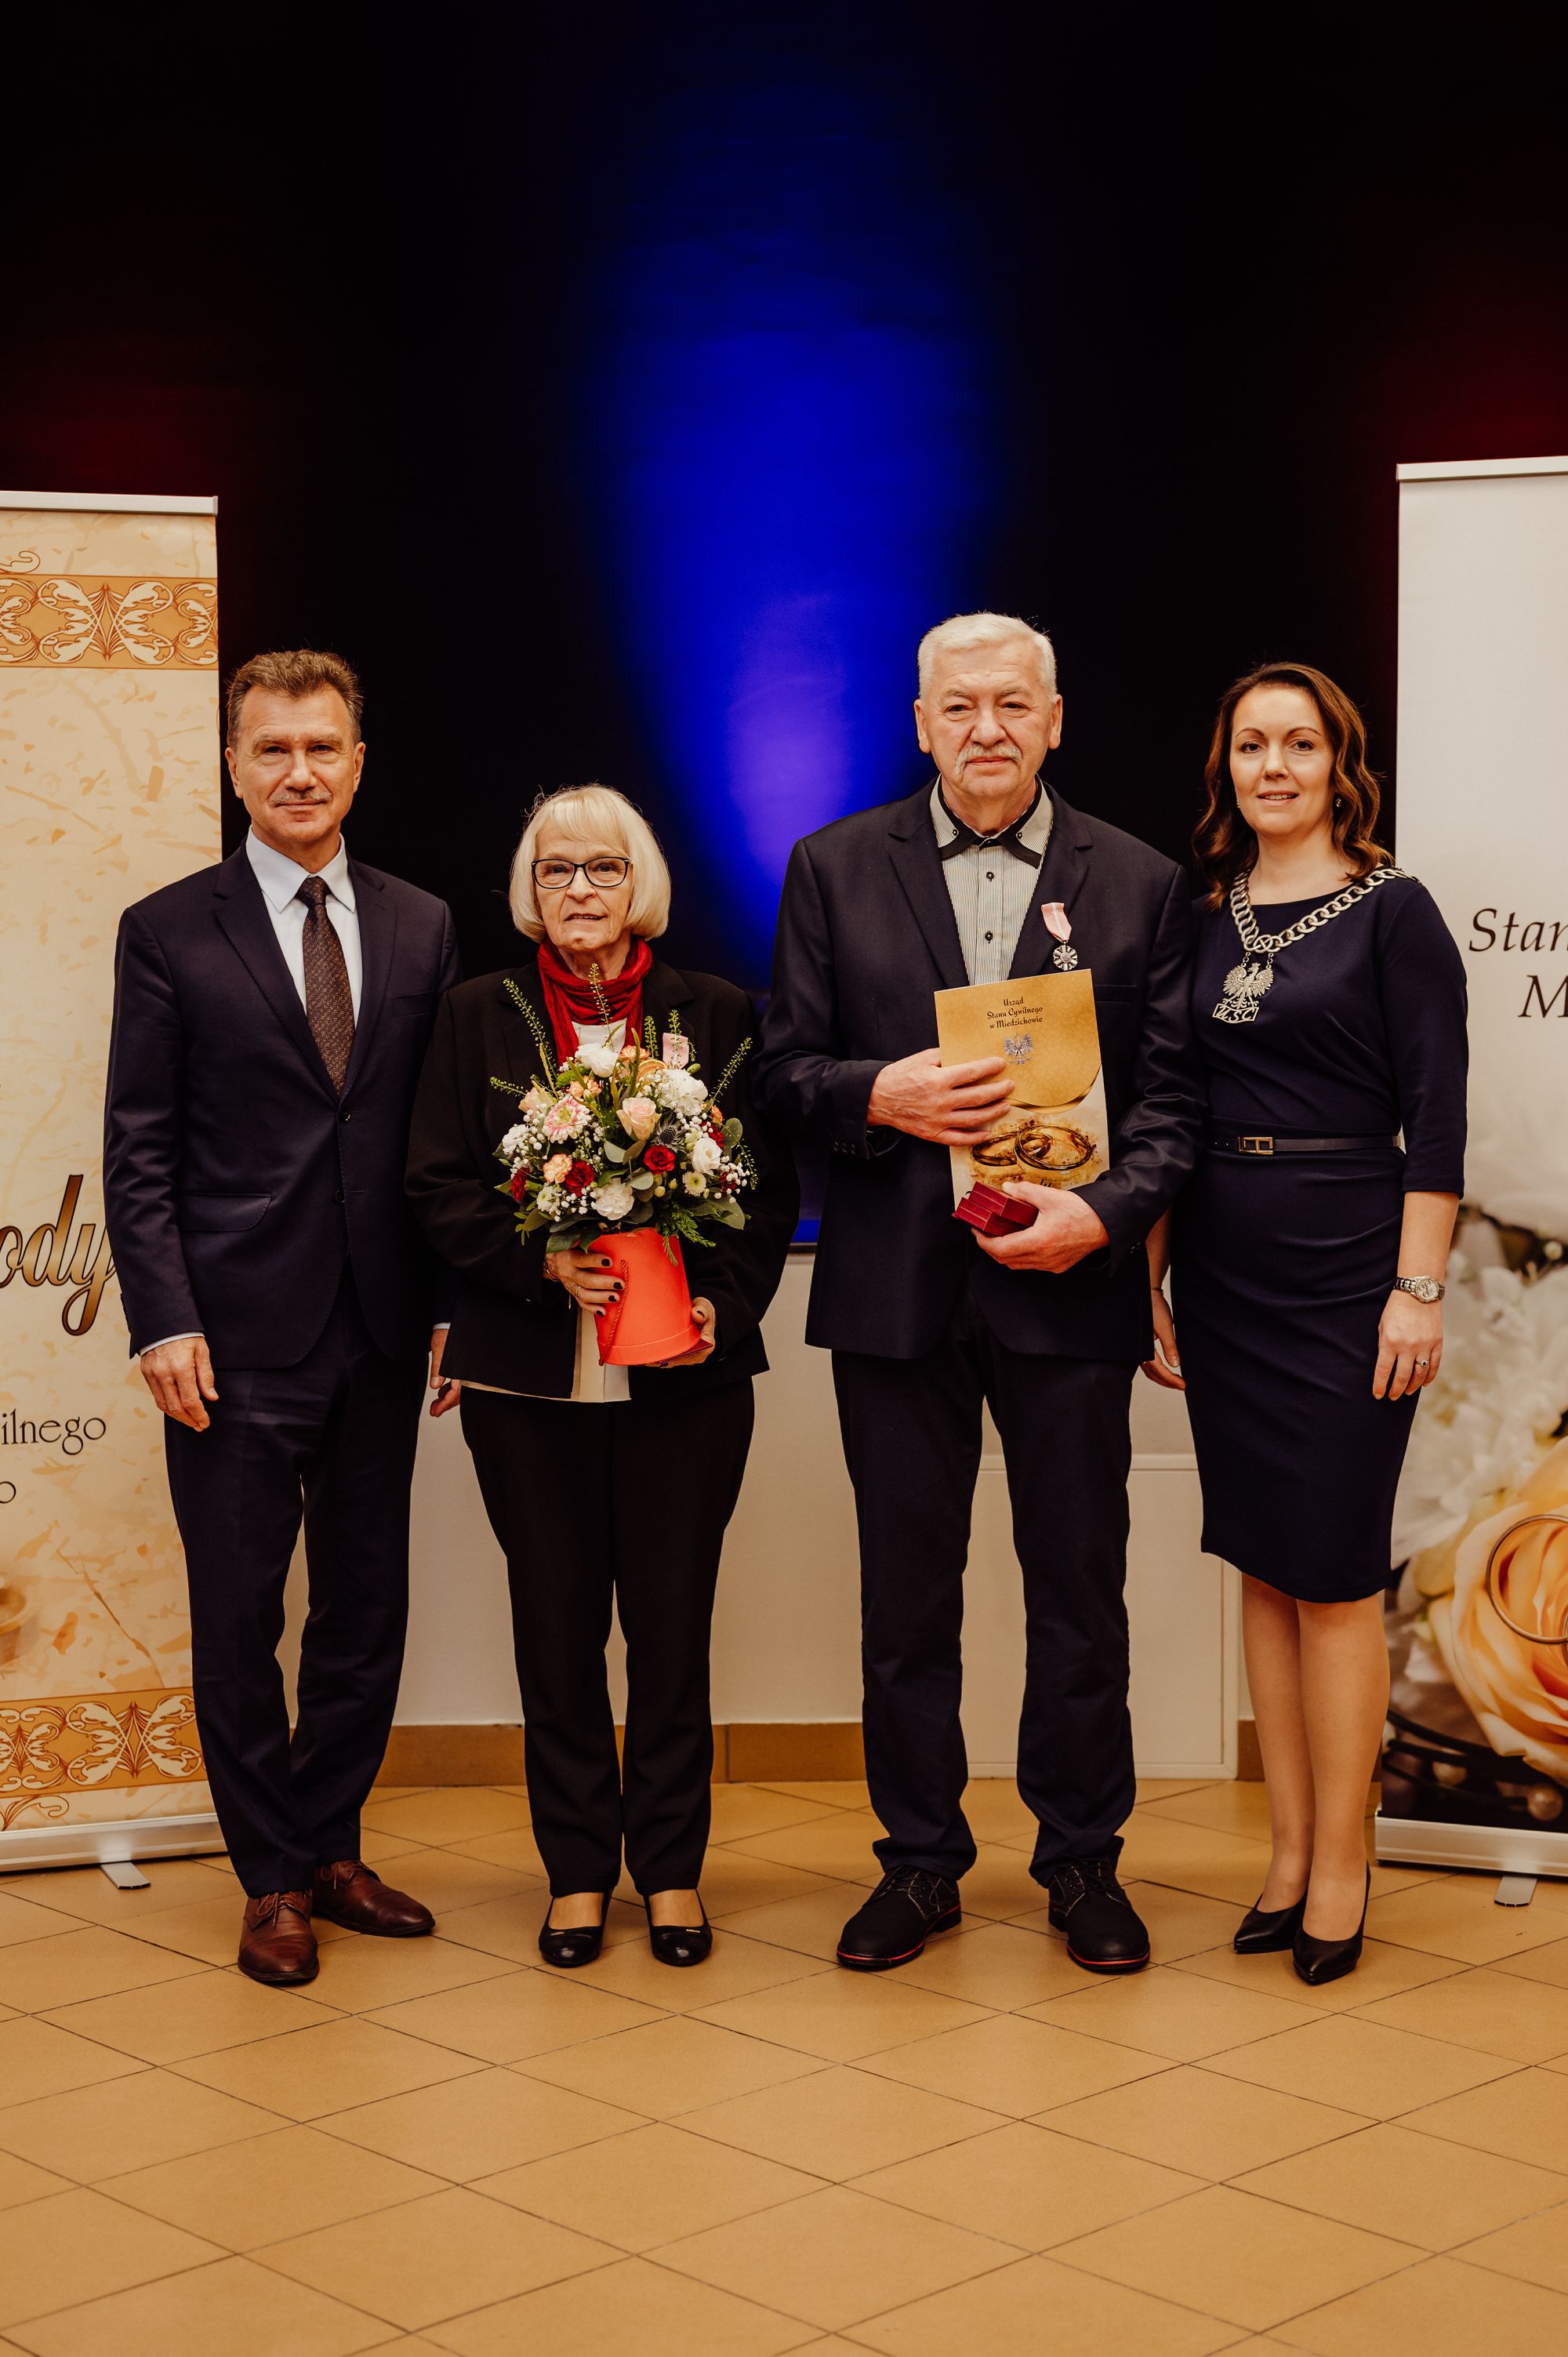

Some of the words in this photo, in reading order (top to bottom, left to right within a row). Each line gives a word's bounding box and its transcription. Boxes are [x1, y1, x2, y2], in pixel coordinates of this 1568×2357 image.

[1518, 975, 1568, 1018] M
[986, 1011, 1007, 1019] Stanu
[1008, 1007, 1044, 1017] Cywilnego
[1216, 1004, 1255, 1022] USC
[996, 1016, 1043, 1029] Miedzichowie
[1, 1408, 107, 1455] ilnego
